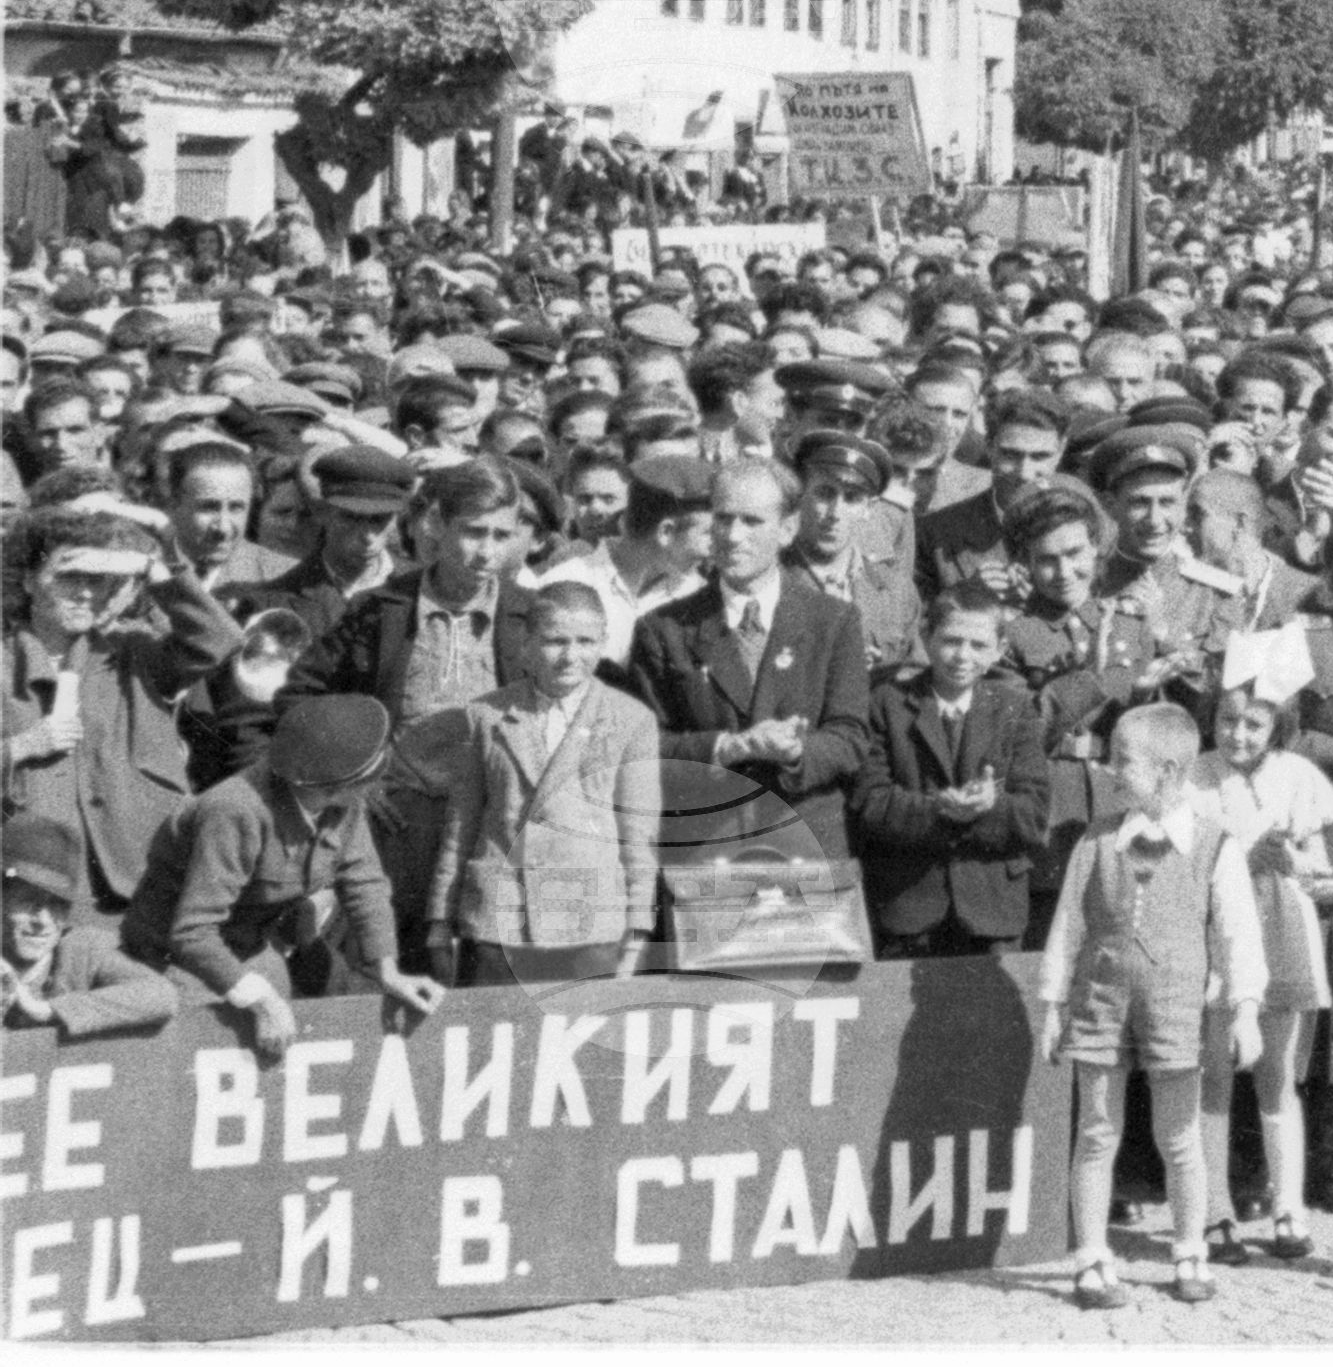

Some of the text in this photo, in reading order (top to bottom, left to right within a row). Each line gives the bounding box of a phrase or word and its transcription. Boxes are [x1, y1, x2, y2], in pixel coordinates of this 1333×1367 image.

[190, 995, 862, 1171] ВЕЛИКИЯТ
[436, 1174, 532, 1288] В.
[614, 1124, 1035, 1269] СТАЛИН
